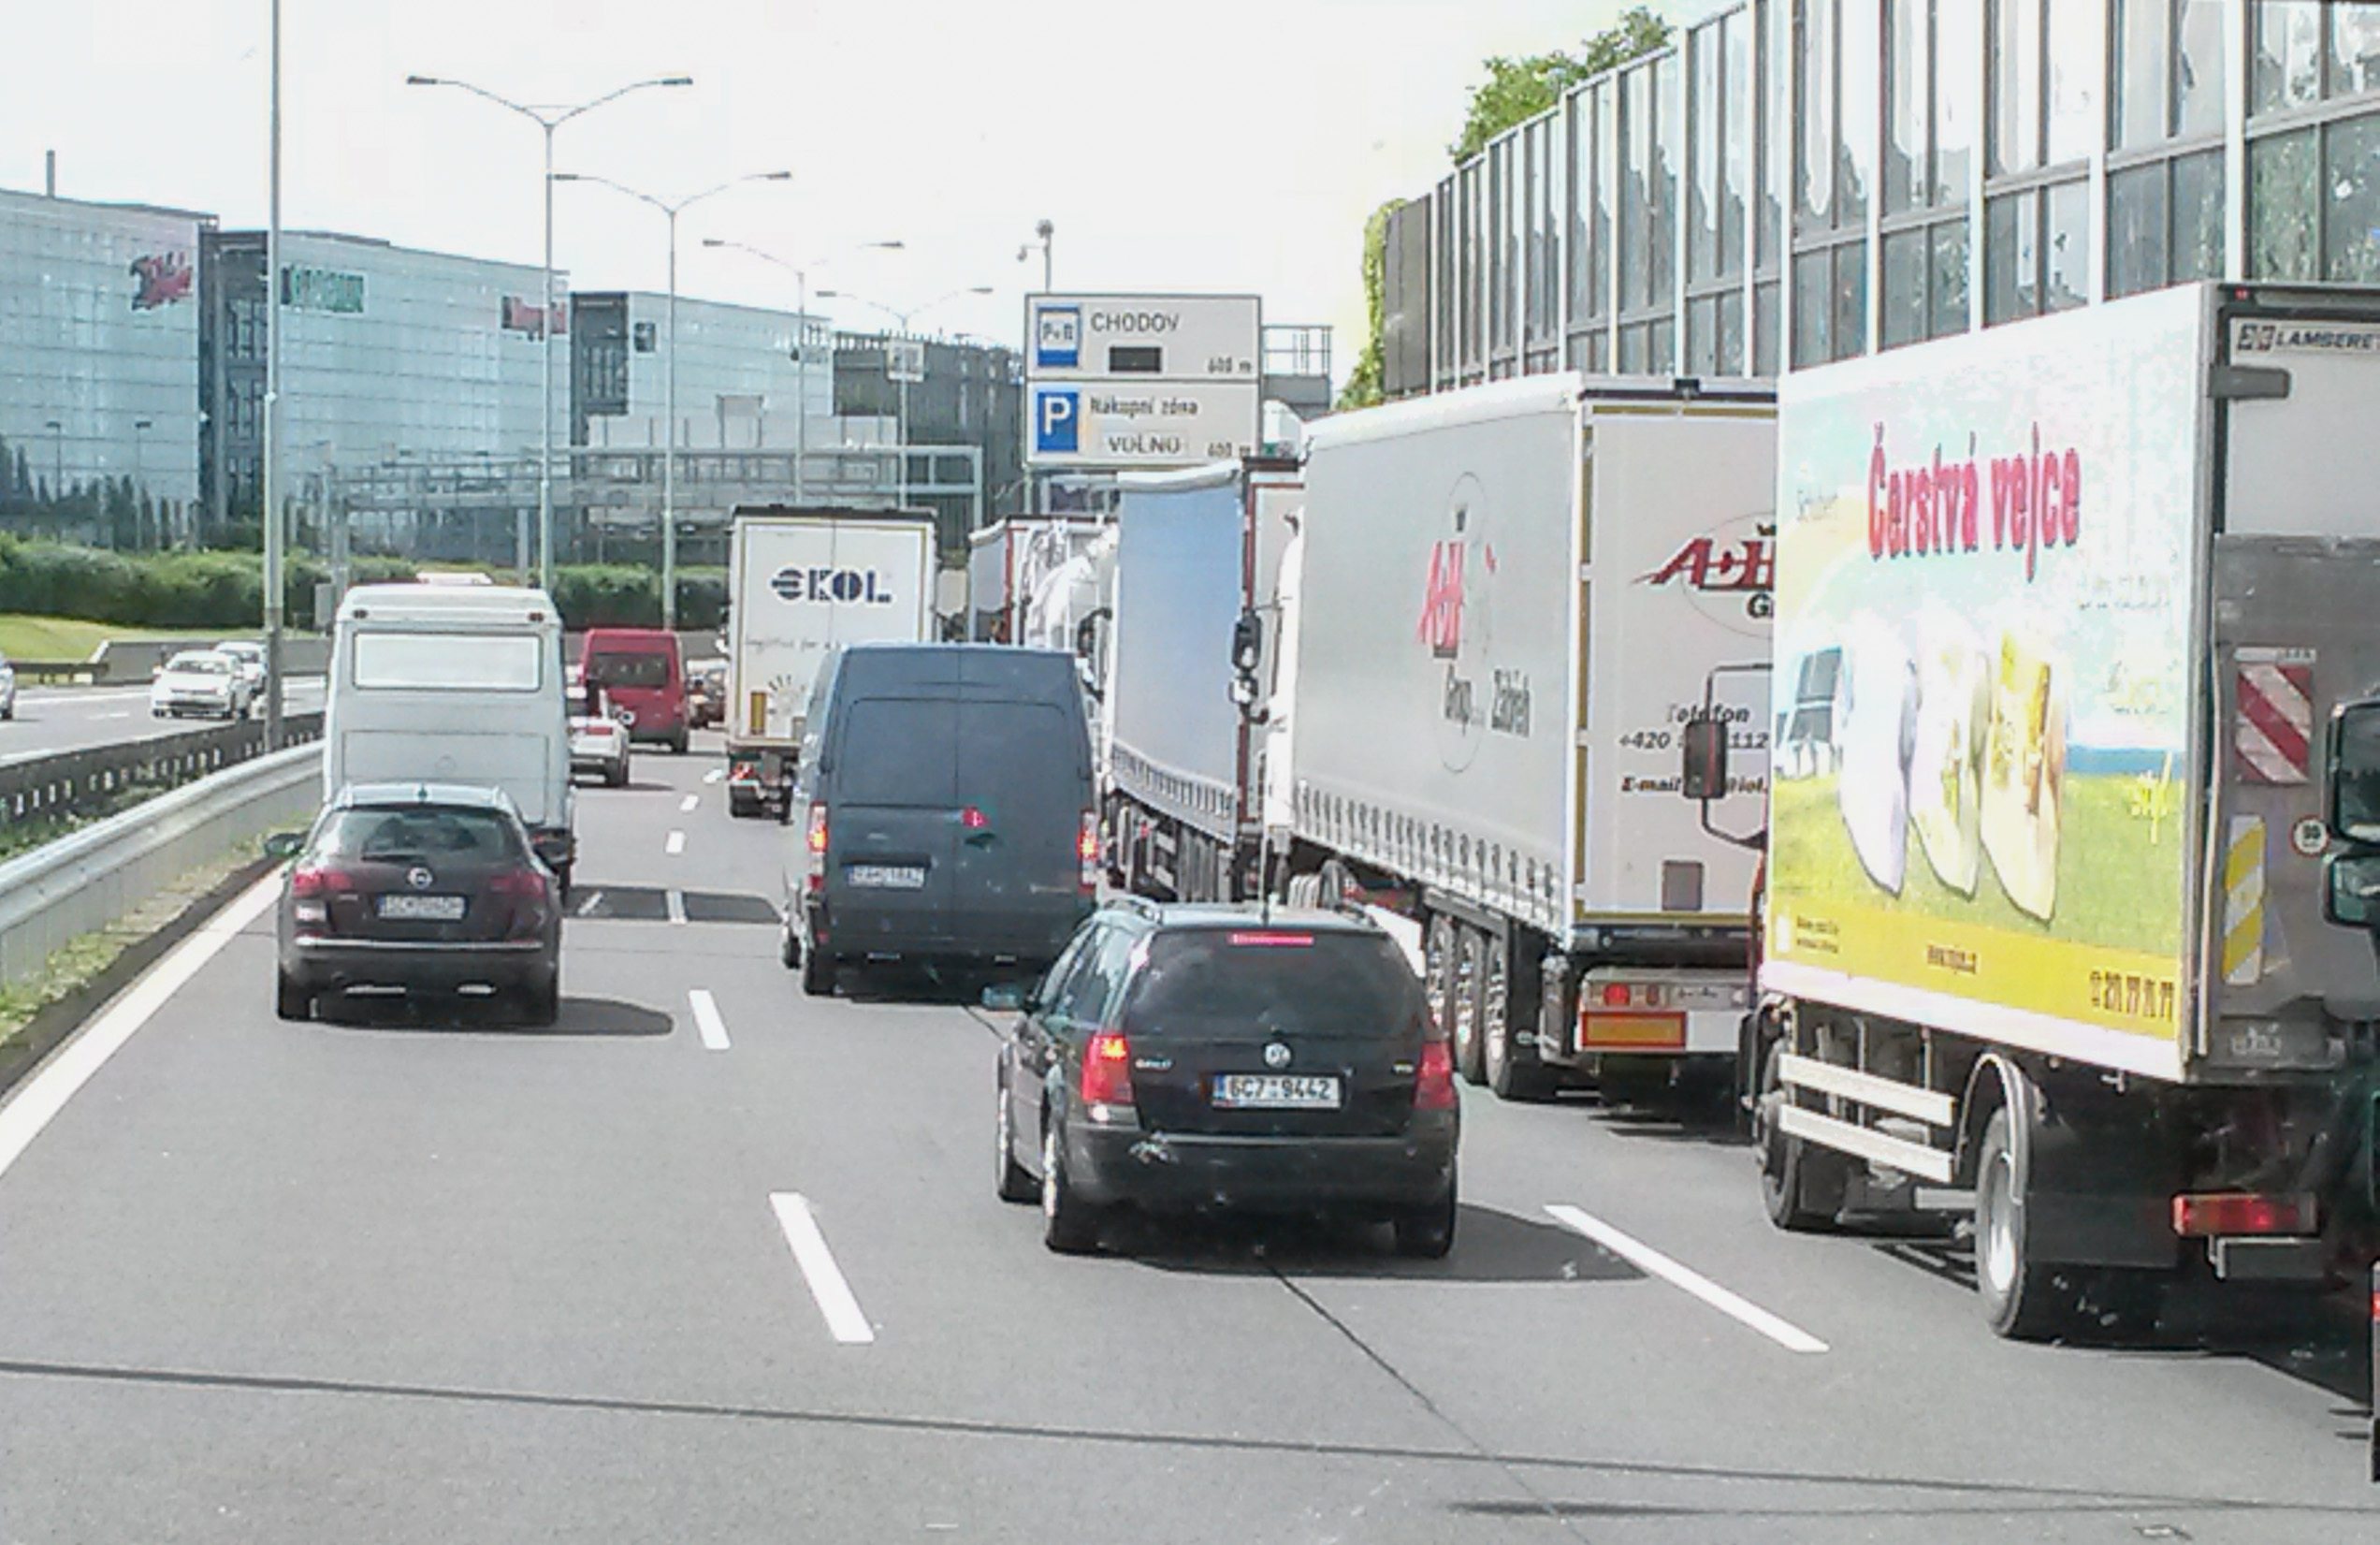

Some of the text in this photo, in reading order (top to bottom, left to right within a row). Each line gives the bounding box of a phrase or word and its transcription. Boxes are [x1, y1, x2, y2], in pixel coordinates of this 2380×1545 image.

[1091, 312, 1179, 332] CHODOV
[1044, 396, 1071, 436] P
[1868, 420, 2082, 585] Čerstvá vejce
[1667, 703, 1751, 723] Telefon
